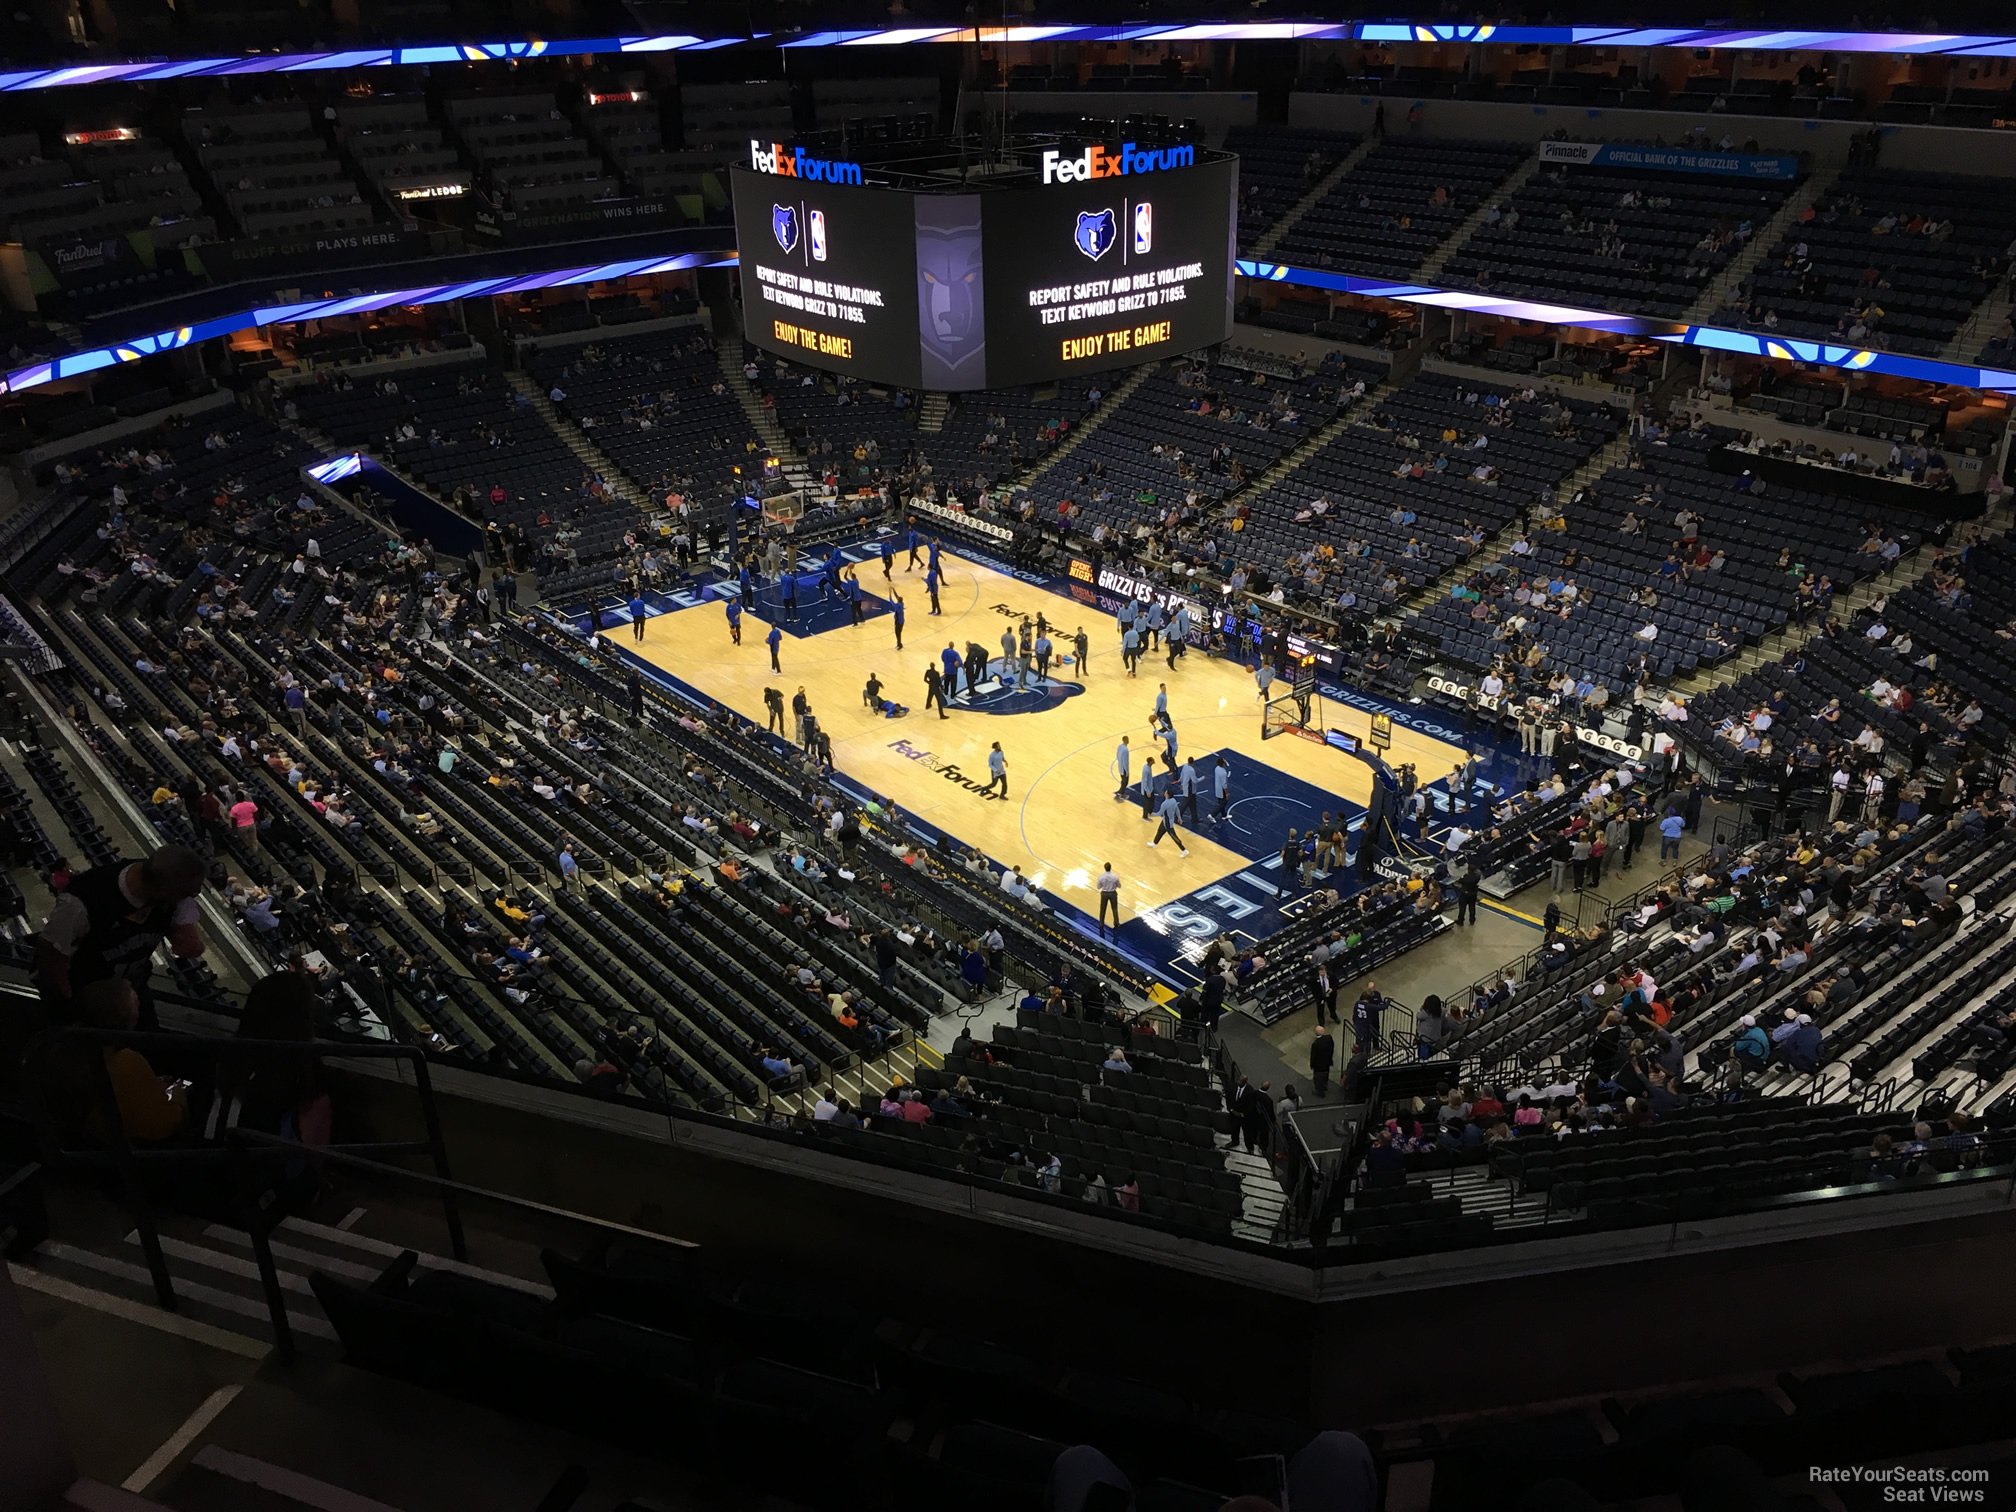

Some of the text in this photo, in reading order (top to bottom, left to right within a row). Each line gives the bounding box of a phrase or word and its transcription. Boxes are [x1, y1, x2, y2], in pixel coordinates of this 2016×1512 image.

[750, 139, 862, 186] FedExForum
[1042, 142, 1194, 185] FedExForum
[1545, 144, 1588, 159] Pinnacle
[1609, 151, 1740, 170] OFFICIAL BANK OF THE GRIZZLIES
[431, 185, 463, 197] LEDGE
[603, 206, 633, 219] WINS
[635, 203, 668, 216] HERE.
[54, 242, 103, 265] FanDuel
[231, 246, 276, 261] BLUFF
[316, 236, 358, 251] PLAYS
[362, 232, 400, 247] HERE.
[756, 264, 885, 307] REPORT SAFETY AND RULE VIOLATIONS.
[762, 286, 775, 302] TEXT
[805, 296, 826, 315] GRIZZ
[827, 302, 838, 318] TO
[1029, 262, 1204, 307] REPORT SAFETY AND RULE VIOLATIONS.
[1041, 285, 1187, 325] TEXT KEYWORD GRIZZ TO 71855.
[774, 319, 853, 359] ENJOY THE GAME!
[1061, 321, 1171, 361] ENJOY THE GAME!
[1319, 685, 1463, 742] GRIZZLIES.COM
[887, 739, 999, 801] FedExForum
